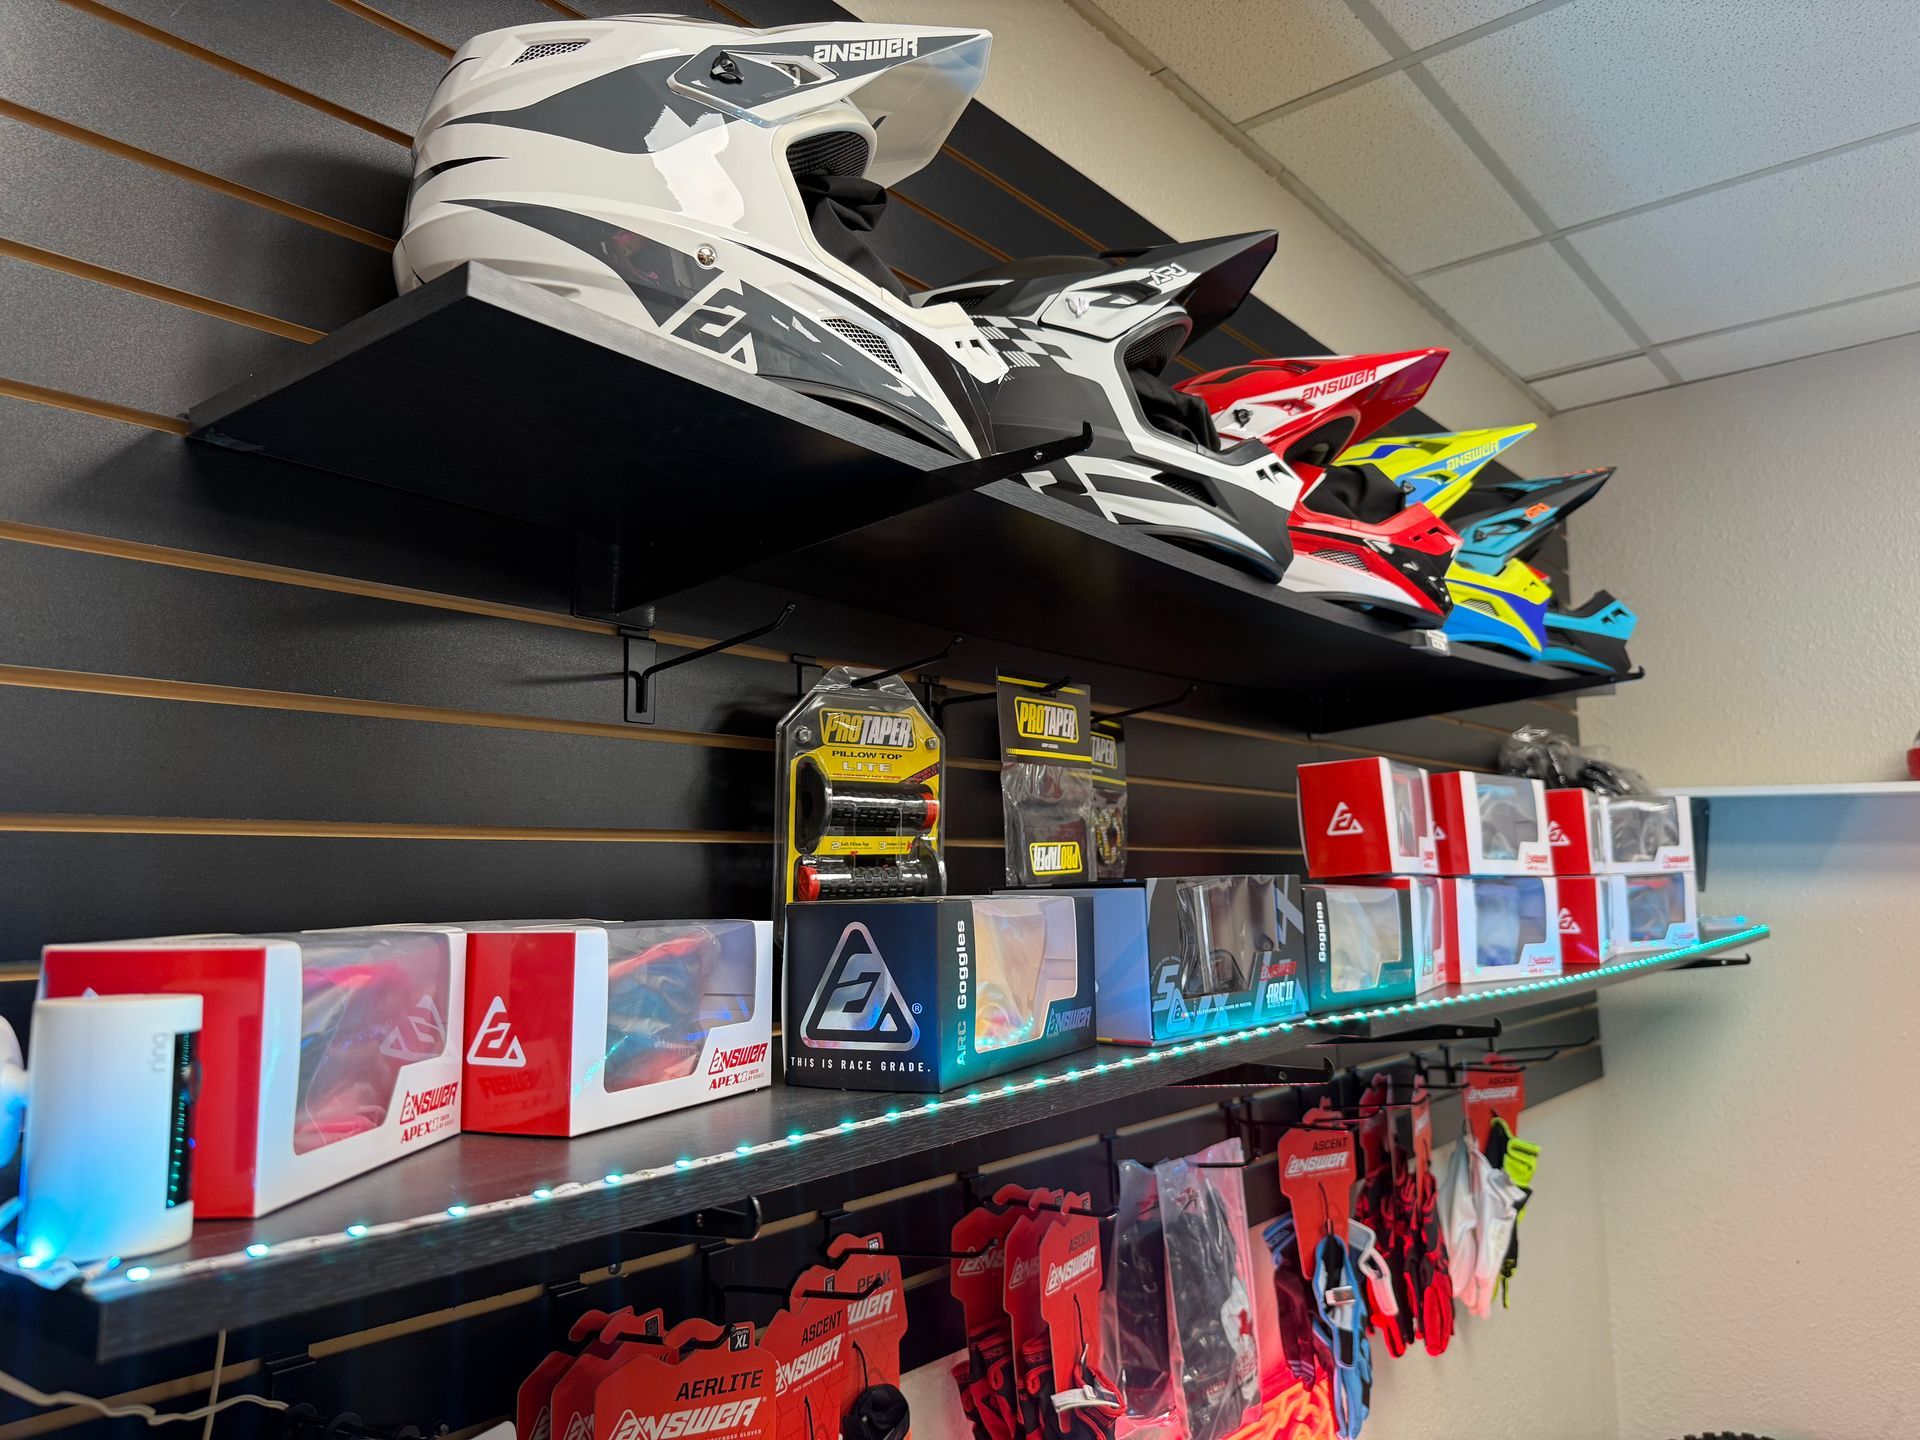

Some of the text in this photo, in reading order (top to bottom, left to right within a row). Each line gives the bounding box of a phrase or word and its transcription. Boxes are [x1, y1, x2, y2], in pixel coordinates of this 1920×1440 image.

[813, 37, 918, 63] ANSWER
[1302, 368, 1377, 400] ANSWER
[1019, 702, 1076, 740] PROTAPER
[832, 750, 877, 759] PILLOW
[842, 761, 893, 773] LITE
[1091, 735, 1116, 768] TAPER
[956, 920, 969, 1066] ARC Goggles
[708, 1042, 769, 1076] ANSWER
[791, 1056, 931, 1072] THIS IS RACE GRADE.
[400, 1080, 459, 1126] ANSWER
[1312, 1137, 1349, 1152] ASCENT
[1284, 1151, 1350, 1178] ANSWER
[1045, 1246, 1097, 1296] ANSWER
[734, 1334, 749, 1350] XL
[801, 1309, 843, 1346] ASCENT
[674, 1369, 764, 1401] AERLITE
[609, 1396, 762, 1440] ANSWER
